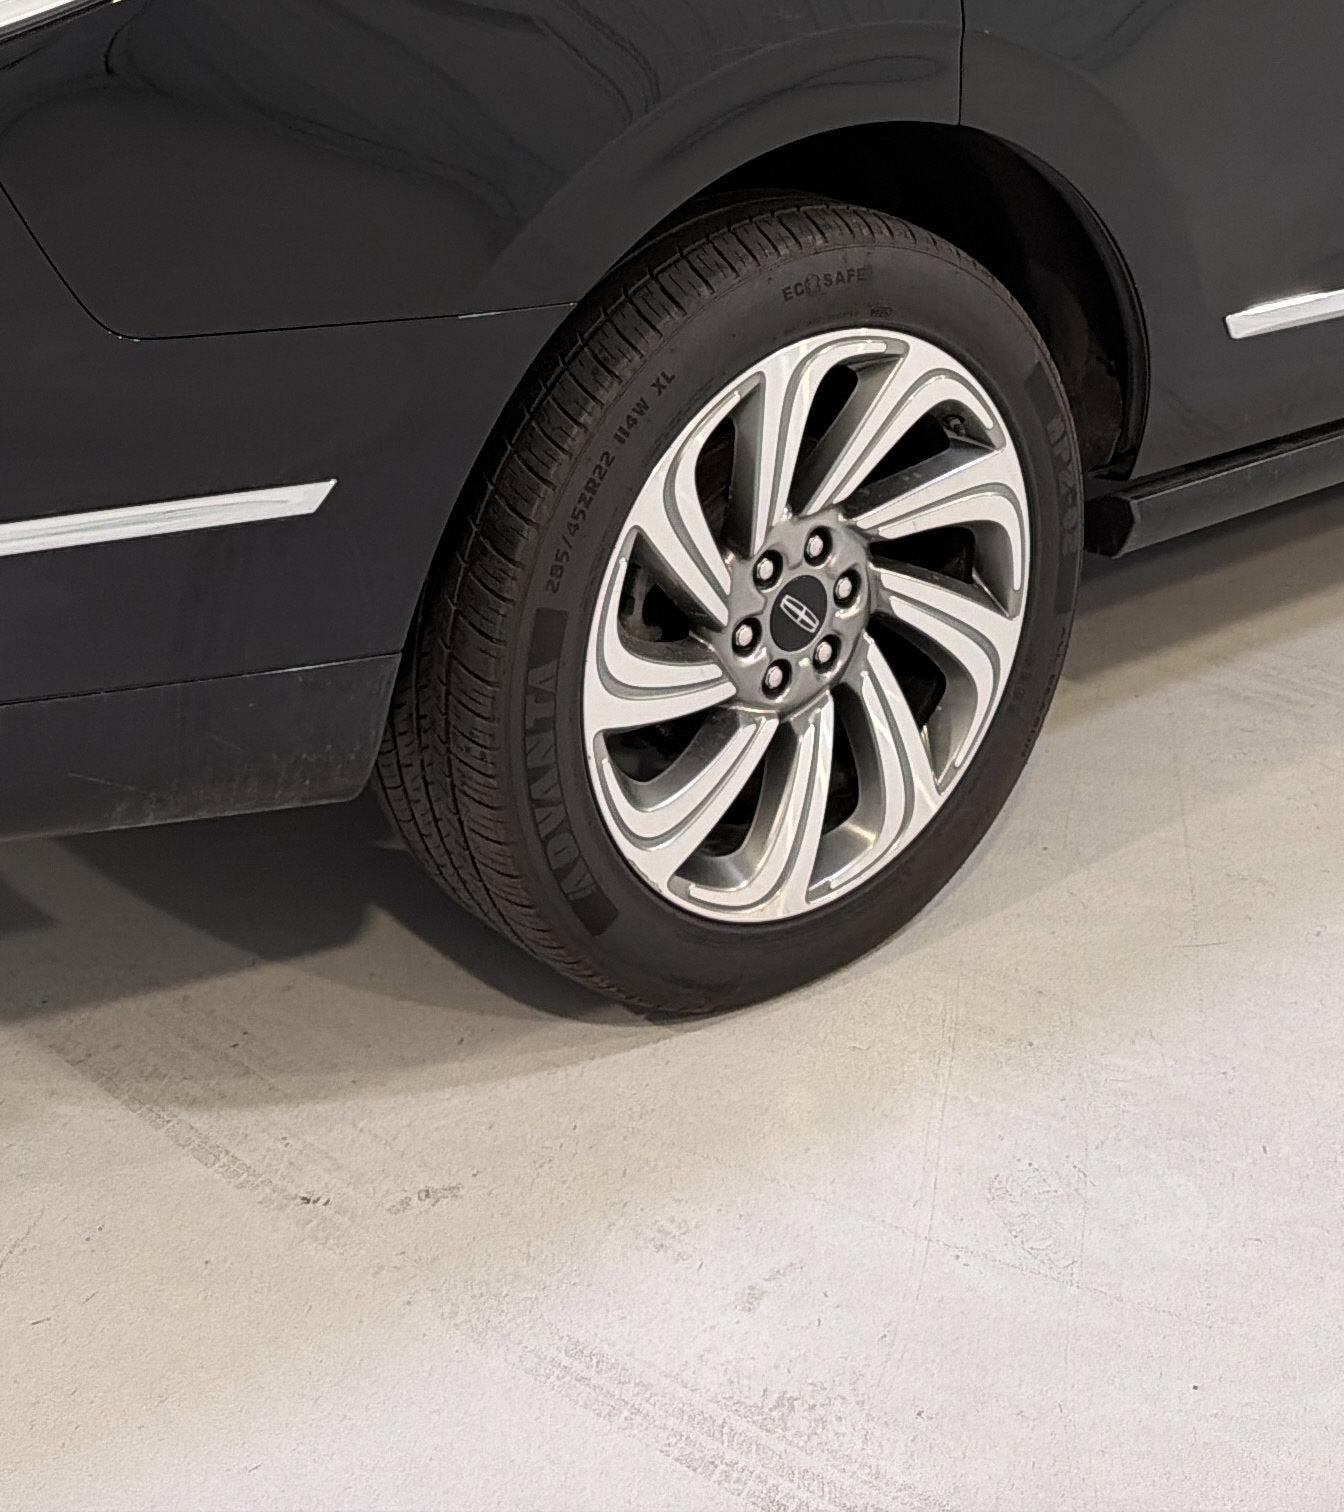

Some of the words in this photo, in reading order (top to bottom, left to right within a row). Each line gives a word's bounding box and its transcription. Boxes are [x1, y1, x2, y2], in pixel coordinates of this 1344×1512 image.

[545, 450, 616, 594] 285/45ZR22
[612, 396, 650, 445] 114W
[650, 371, 676, 397] XL
[524, 657, 599, 901] ADVANTA
